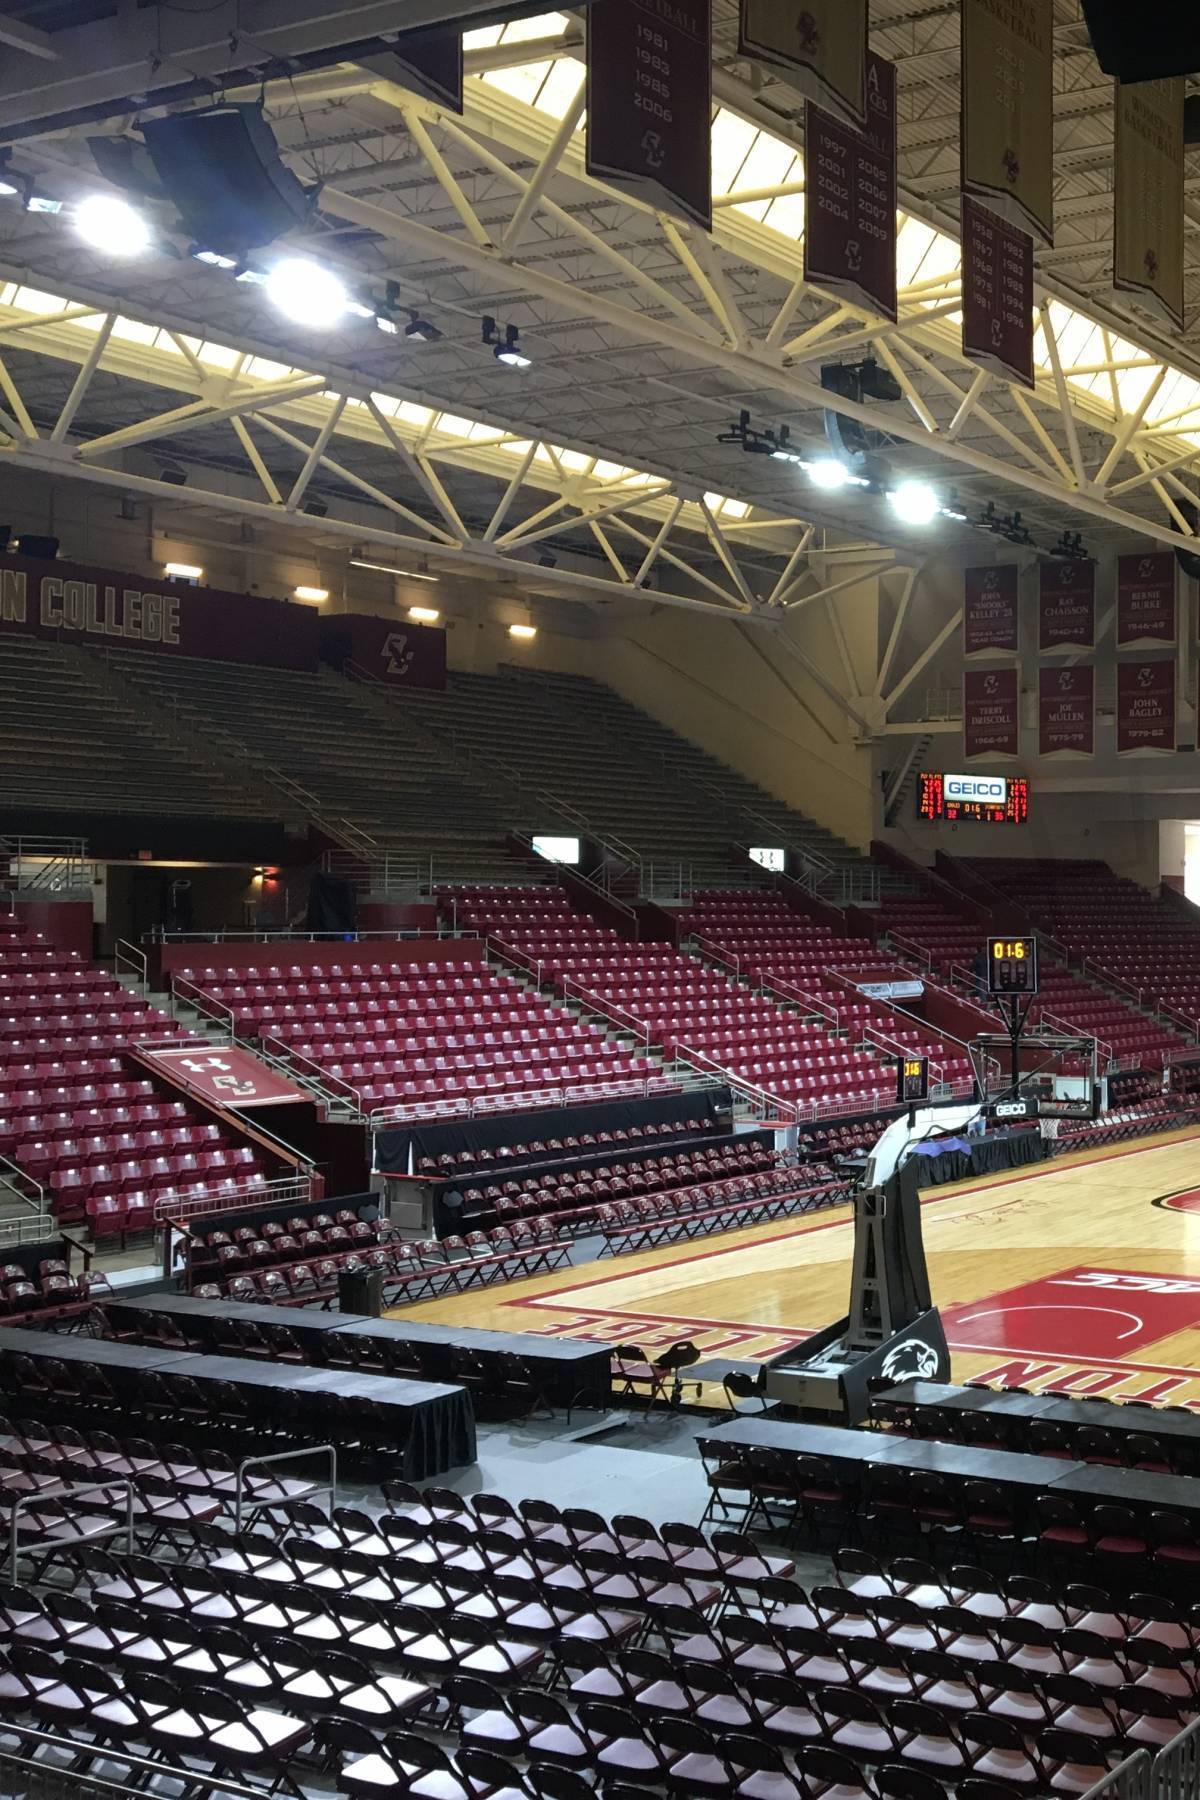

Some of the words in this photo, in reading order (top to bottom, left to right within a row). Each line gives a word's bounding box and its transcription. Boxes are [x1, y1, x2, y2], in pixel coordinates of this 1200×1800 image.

[636, 24, 668, 52] 1981
[634, 46, 670, 76] 1983
[635, 69, 671, 98] 1985
[633, 92, 673, 123] 2006
[818, 133, 847, 159] 1997
[817, 153, 846, 179] 2001
[857, 157, 888, 183] 2005
[817, 174, 849, 201] 2002
[858, 178, 888, 203] 2006
[818, 194, 849, 221] 2004
[858, 198, 888, 222] 2007
[1131, 591, 1160, 600] BERNIE
[40, 576, 180, 644] COLLEGE
[1044, 606, 1089, 617] CHAISSON
[1131, 600, 1160, 610] BURKE
[969, 608, 1000, 619] KELLEY
[979, 707, 1003, 715] TERRY
[1060, 703, 1072, 713] JOE
[1134, 699, 1158, 710] JOHN
[1048, 713, 1084, 722] MULLEN
[1129, 708, 1162, 717] BAGLEY
[971, 715, 1011, 725] DRISCOLL
[948, 782, 1002, 796] GEICO
[996, 1103, 1026, 1116] GEICO
